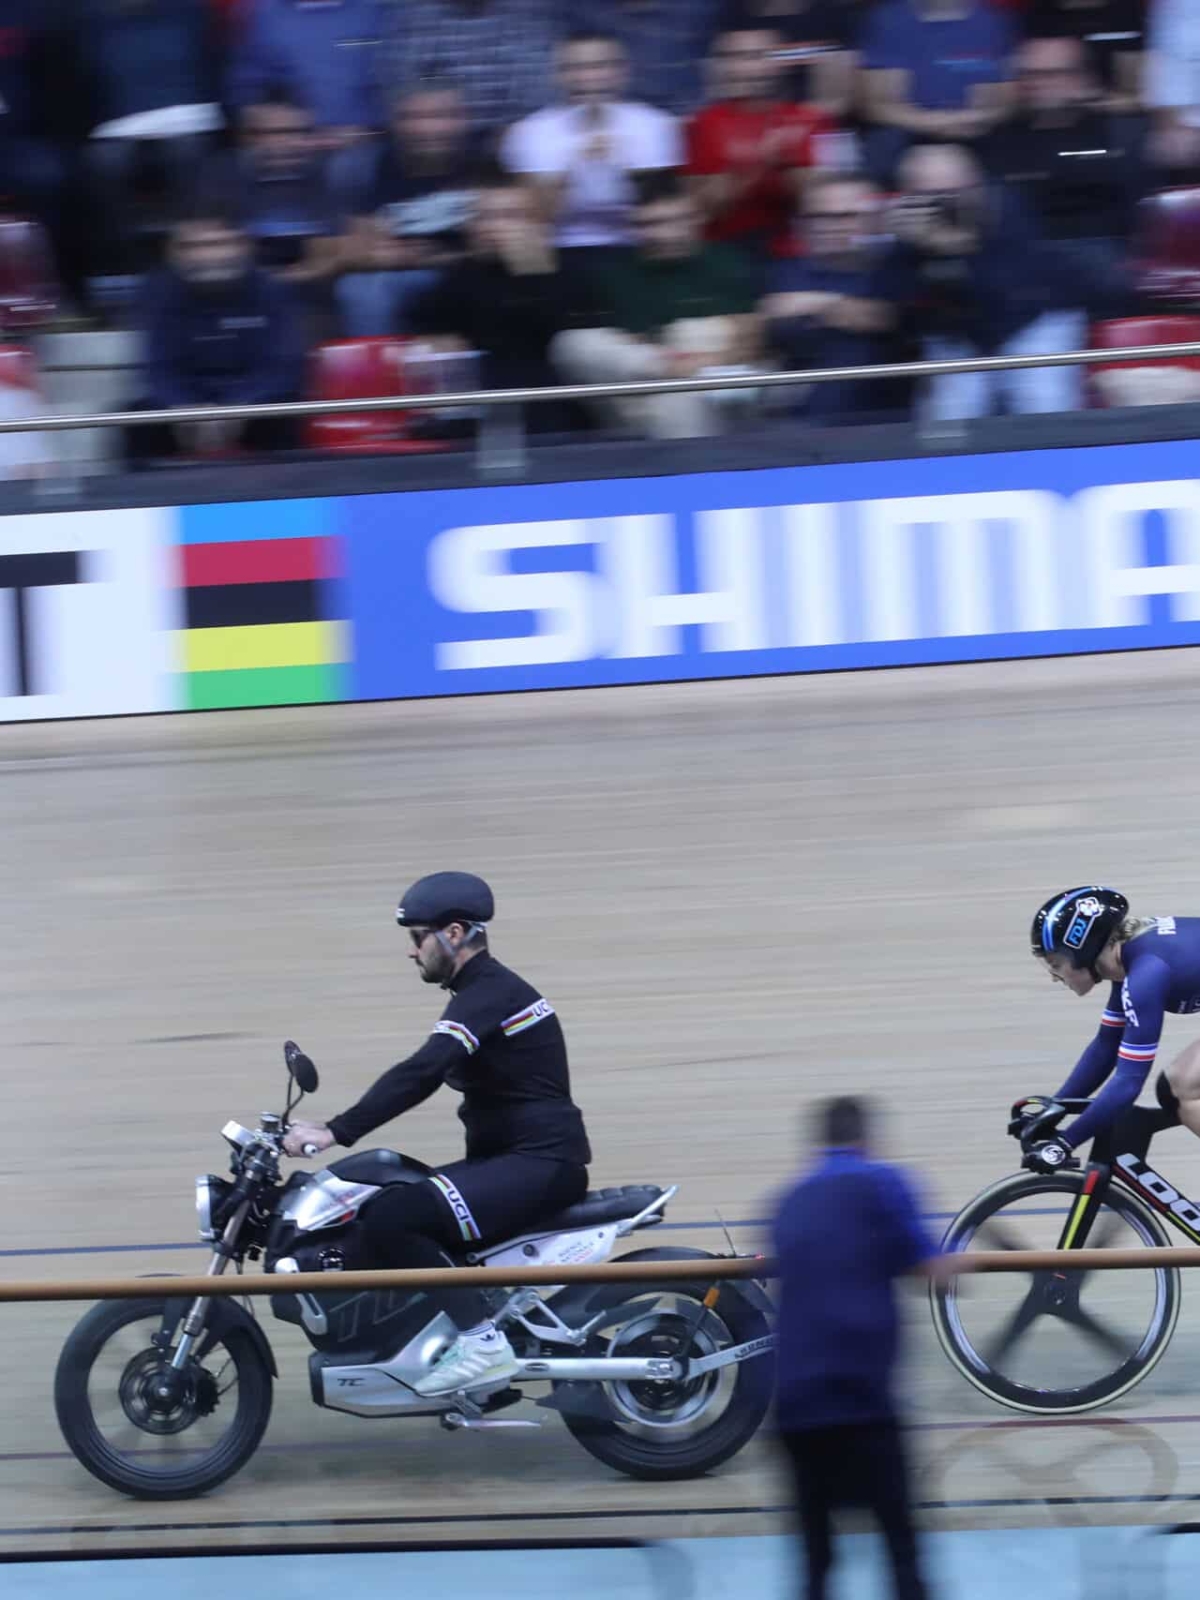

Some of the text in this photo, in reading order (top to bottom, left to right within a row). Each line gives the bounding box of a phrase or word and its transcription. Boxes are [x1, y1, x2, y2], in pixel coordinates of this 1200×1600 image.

[1068, 917, 1087, 946] FDJ
[447, 1189, 470, 1221] UCI
[336, 1377, 367, 1387] TC
